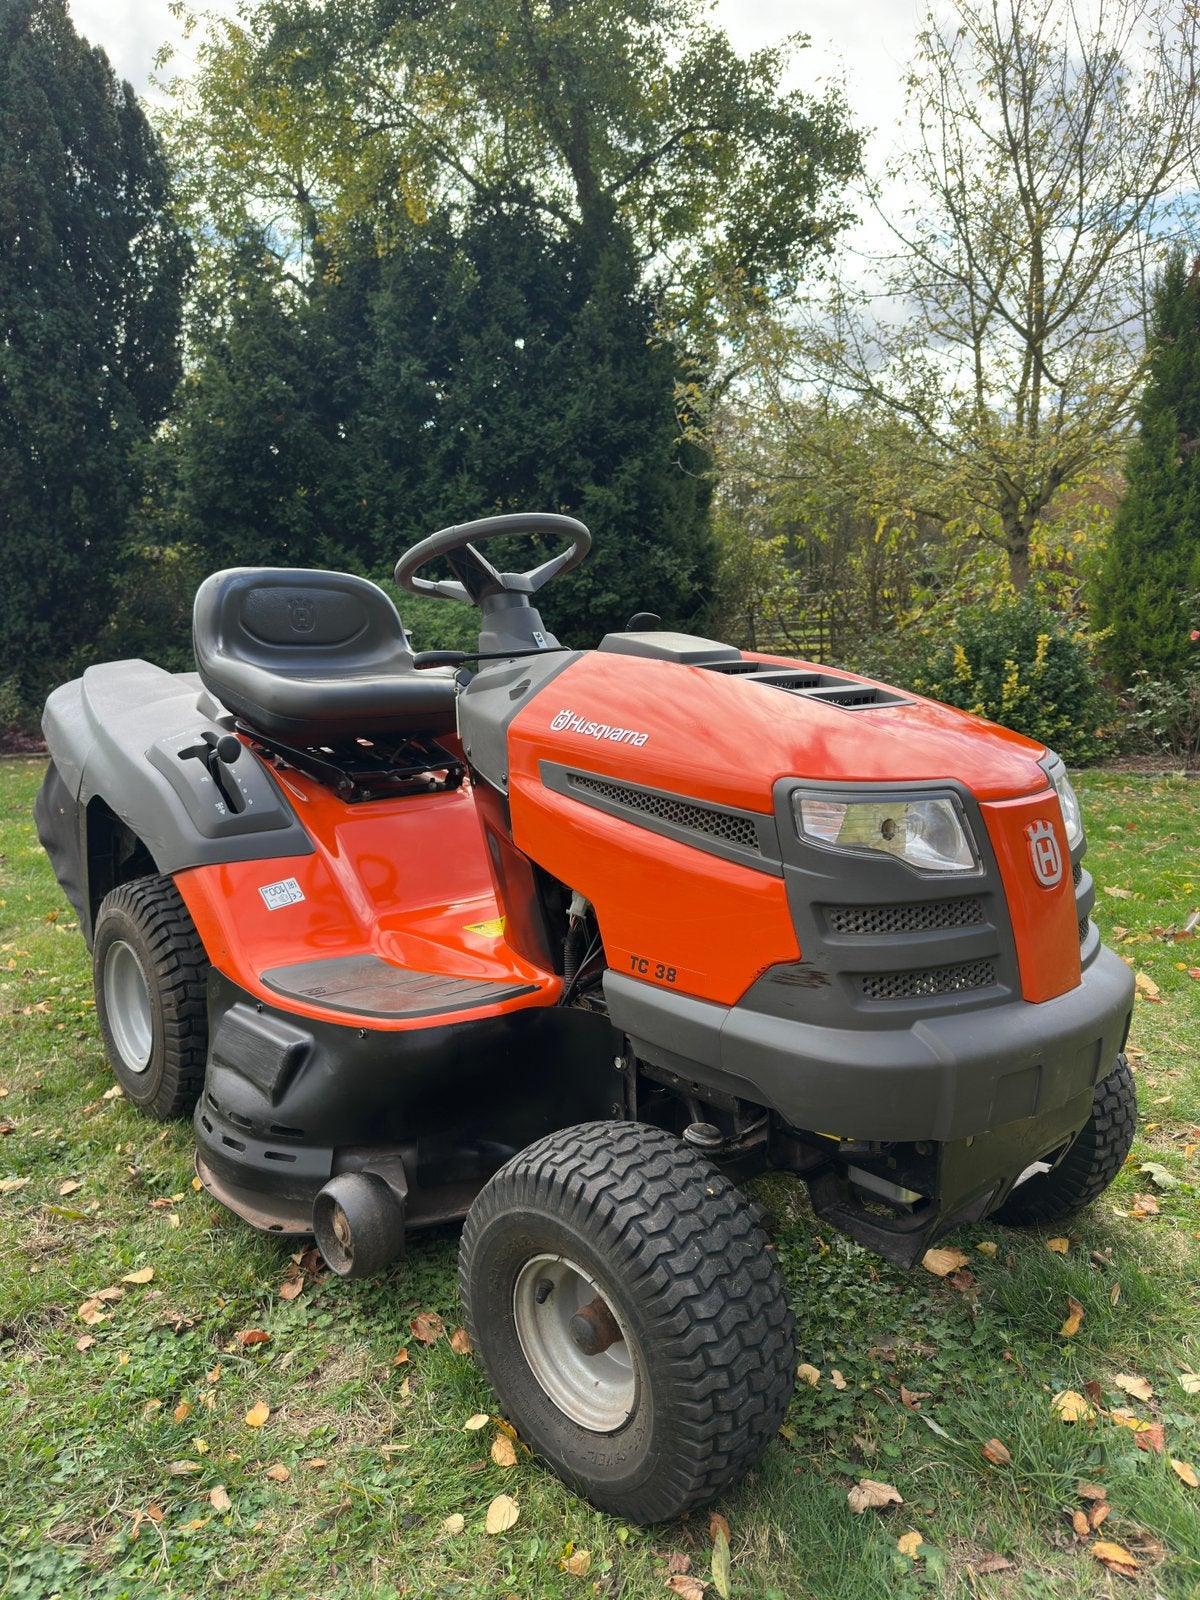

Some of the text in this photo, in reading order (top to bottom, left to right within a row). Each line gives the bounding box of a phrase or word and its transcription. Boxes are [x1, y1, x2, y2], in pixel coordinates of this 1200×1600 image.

[565, 714, 649, 747] Husqvarna
[630, 955, 677, 983] TC 38
